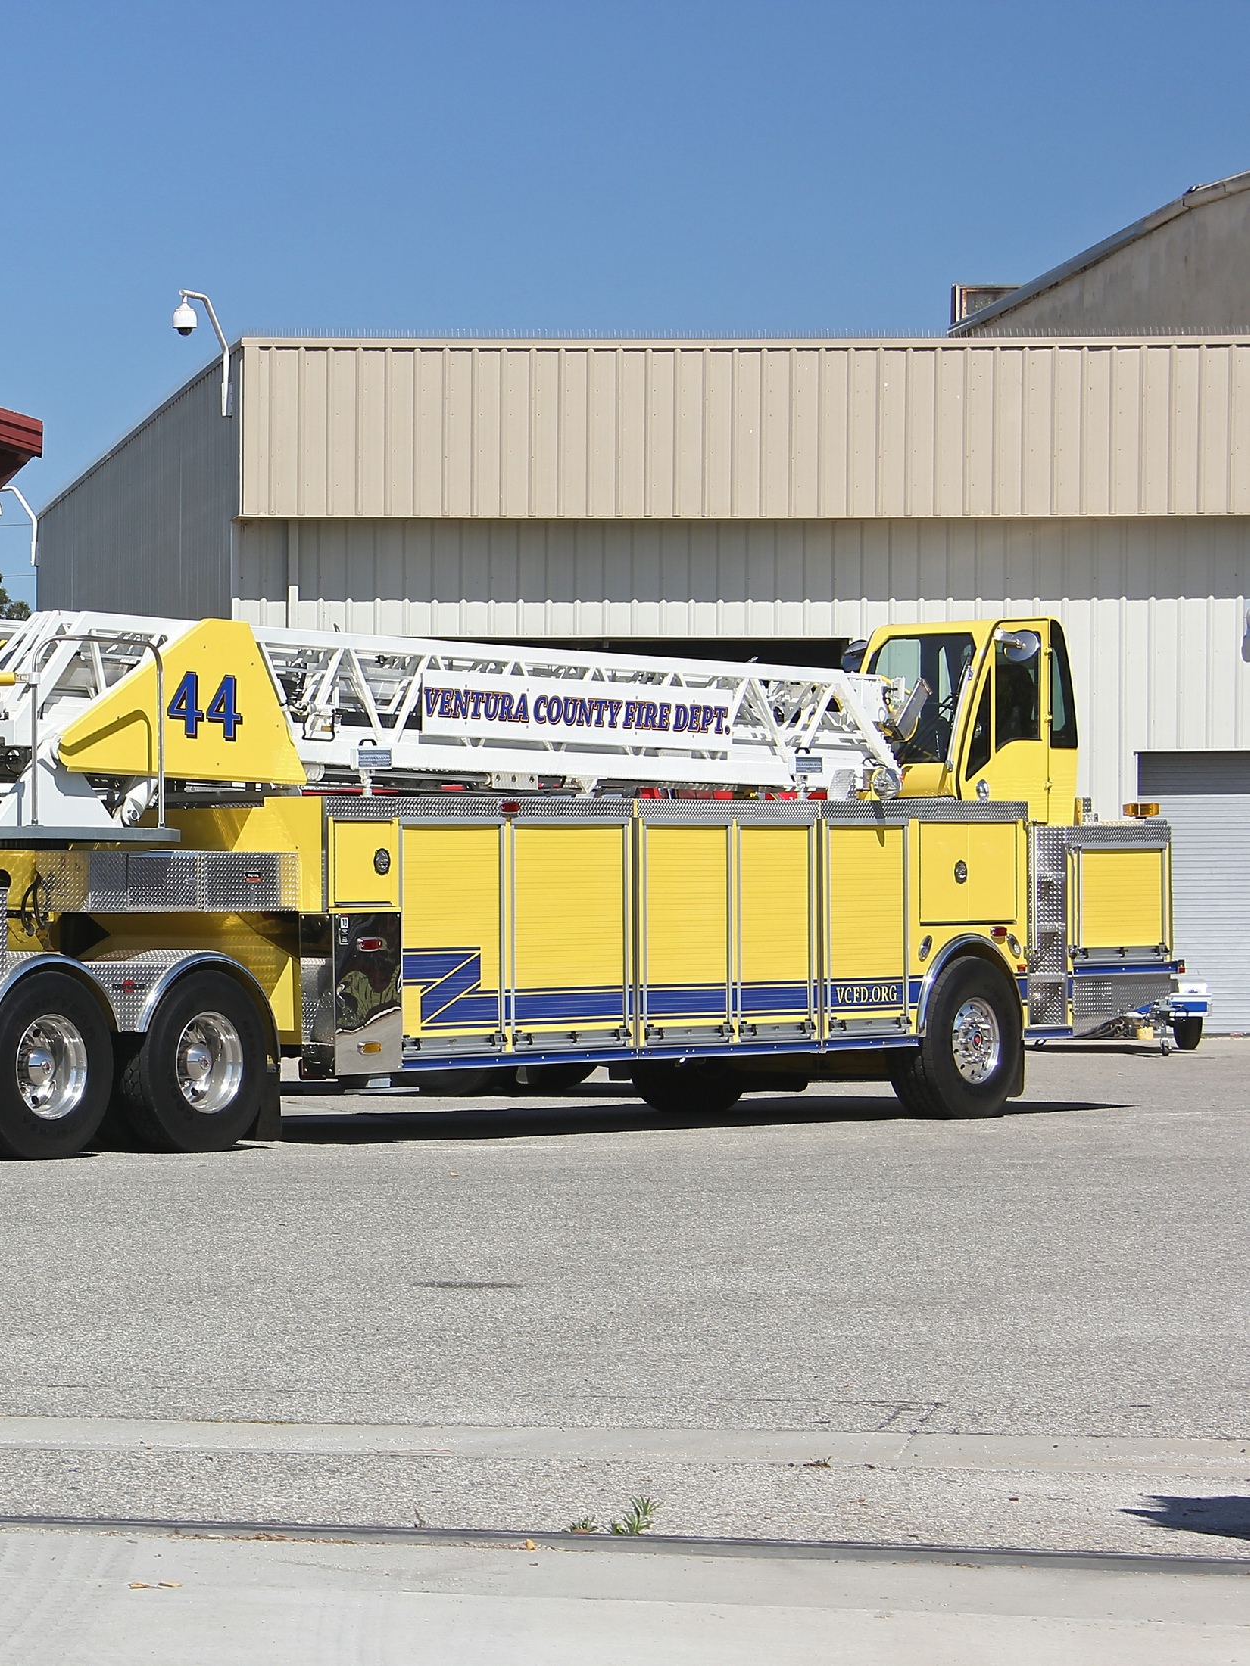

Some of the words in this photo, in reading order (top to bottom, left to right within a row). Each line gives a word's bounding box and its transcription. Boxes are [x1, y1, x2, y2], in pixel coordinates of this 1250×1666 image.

[167, 671, 243, 742] 44
[424, 687, 529, 722] VENTURA
[533, 695, 622, 728] COUNTY
[622, 700, 671, 731] FIRE
[673, 703, 731, 735] DEPT.
[835, 985, 898, 1004] VCFD.ORG
